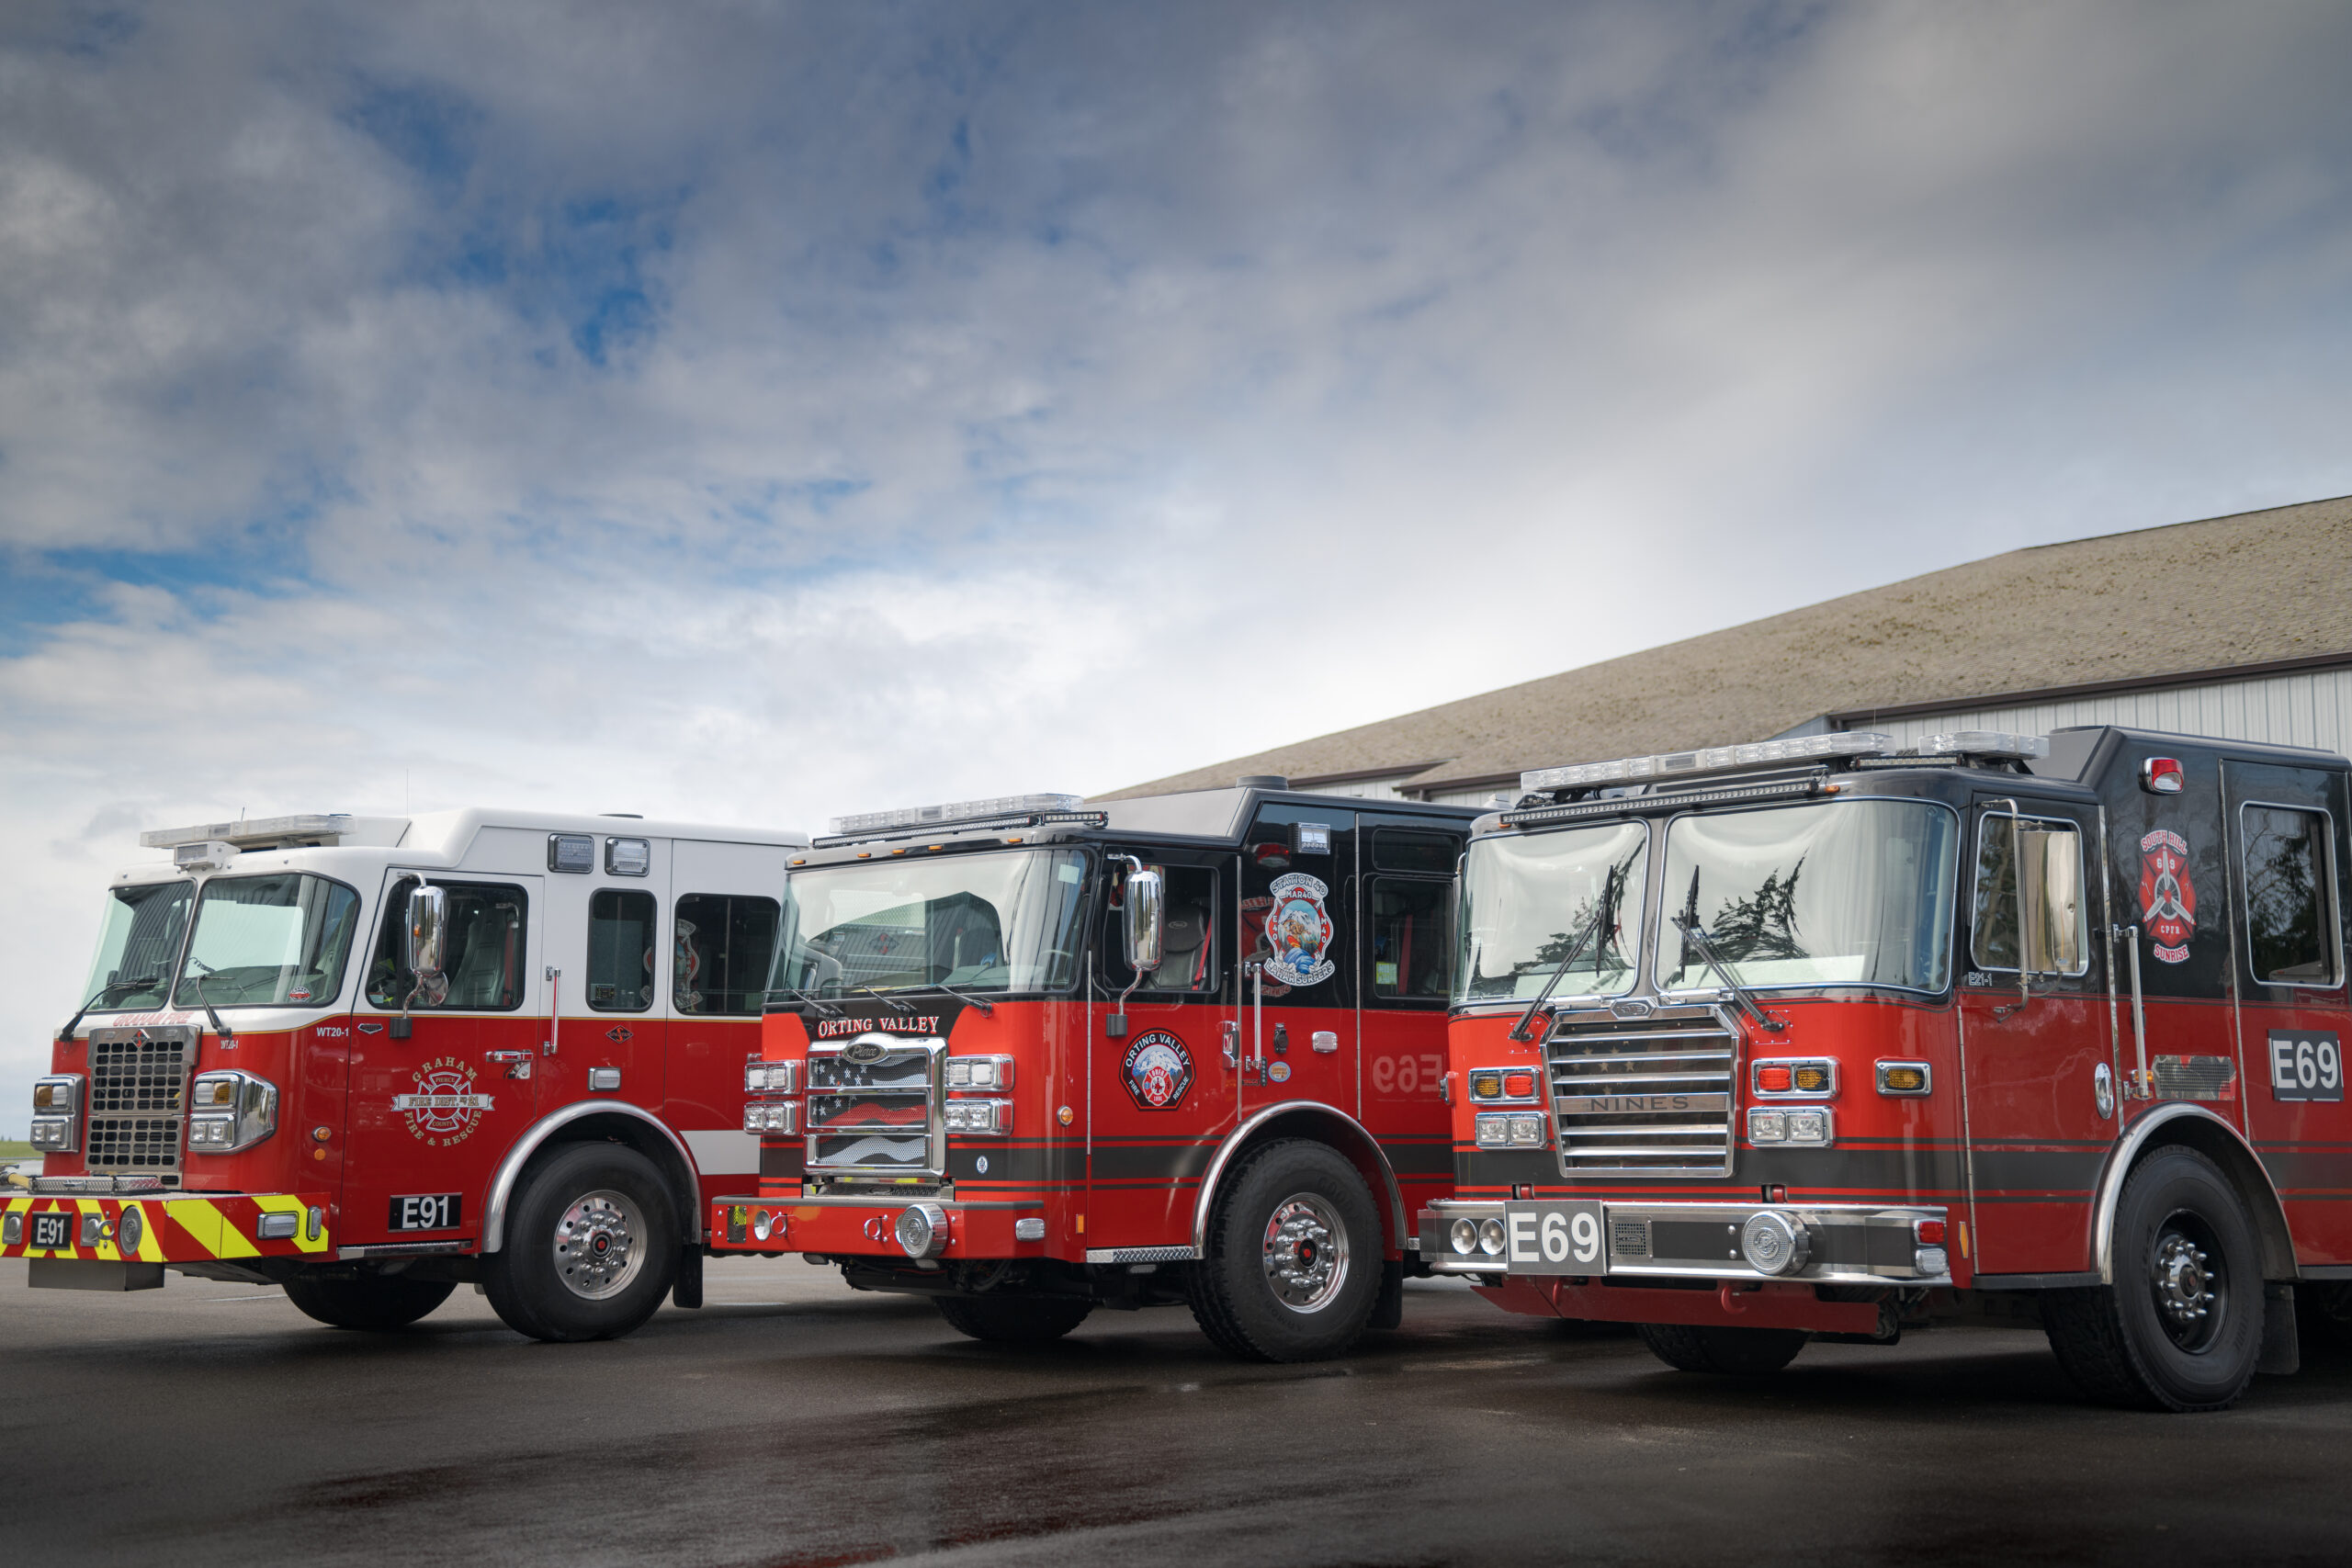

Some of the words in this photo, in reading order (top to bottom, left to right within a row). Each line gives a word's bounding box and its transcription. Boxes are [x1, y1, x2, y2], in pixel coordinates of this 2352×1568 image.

[2141, 829, 2167, 852] SOUTH
[2167, 830, 2188, 855] HILL
[1271, 874, 1314, 895] STATION
[1312, 881, 1327, 896] 40
[1286, 890, 1313, 899] MAR40
[2154, 943, 2190, 963] SUNRISE
[1267, 959, 1296, 984] LAHAR
[1295, 962, 1334, 985] SURFERS
[1968, 972, 1993, 987] E21-1
[113, 1012, 167, 1027] GRAHAM
[164, 1011, 195, 1024] FIRE
[818, 1019, 873, 1039] ORTING
[878, 1016, 940, 1034] VALLEY
[316, 1027, 349, 1037] WT20-1
[1125, 1033, 1156, 1067] ORTING
[1159, 1033, 1191, 1066] VALLEY
[412, 1056, 478, 1082] GRAHAM
[2272, 1040, 2338, 1089] E69
[1128, 1079, 1140, 1096] FIRE
[1172, 1076, 1190, 1100] RESCUE
[409, 1096, 432, 1108] FIRE
[468, 1095, 480, 1108] 21
[1590, 1096, 1690, 1112] NINES
[404, 1111, 424, 1140] FIRE
[427, 1137, 436, 1146] &
[443, 1110, 482, 1147] RESCUE
[432, 1121, 453, 1129] COUNTY
[402, 1195, 449, 1229] E91
[37, 1217, 64, 1245] E91
[1509, 1212, 1600, 1263] E69
